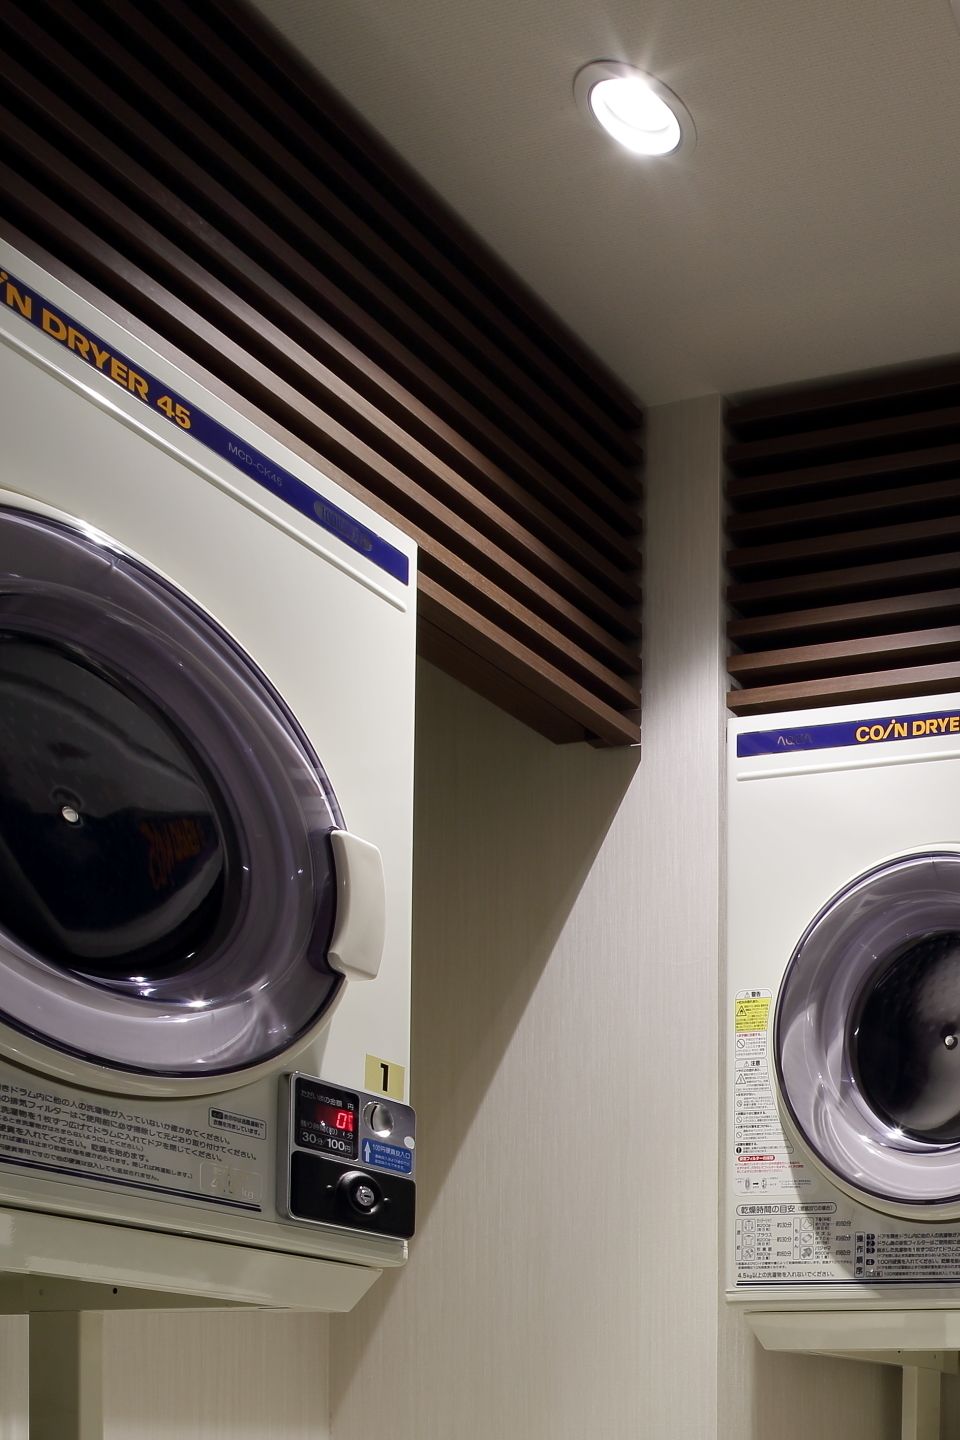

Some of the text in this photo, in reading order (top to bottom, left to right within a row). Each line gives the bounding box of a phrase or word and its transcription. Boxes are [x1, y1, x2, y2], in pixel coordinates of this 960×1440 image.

[0, 271, 282, 487] N DRYER 45 MCD-CK45
[855, 718, 908, 742] COIN
[380, 1063, 389, 1092] 1
[327, 1138, 351, 1152] 100円
[741, 1205, 795, 1214] 乾燥時間の目安
